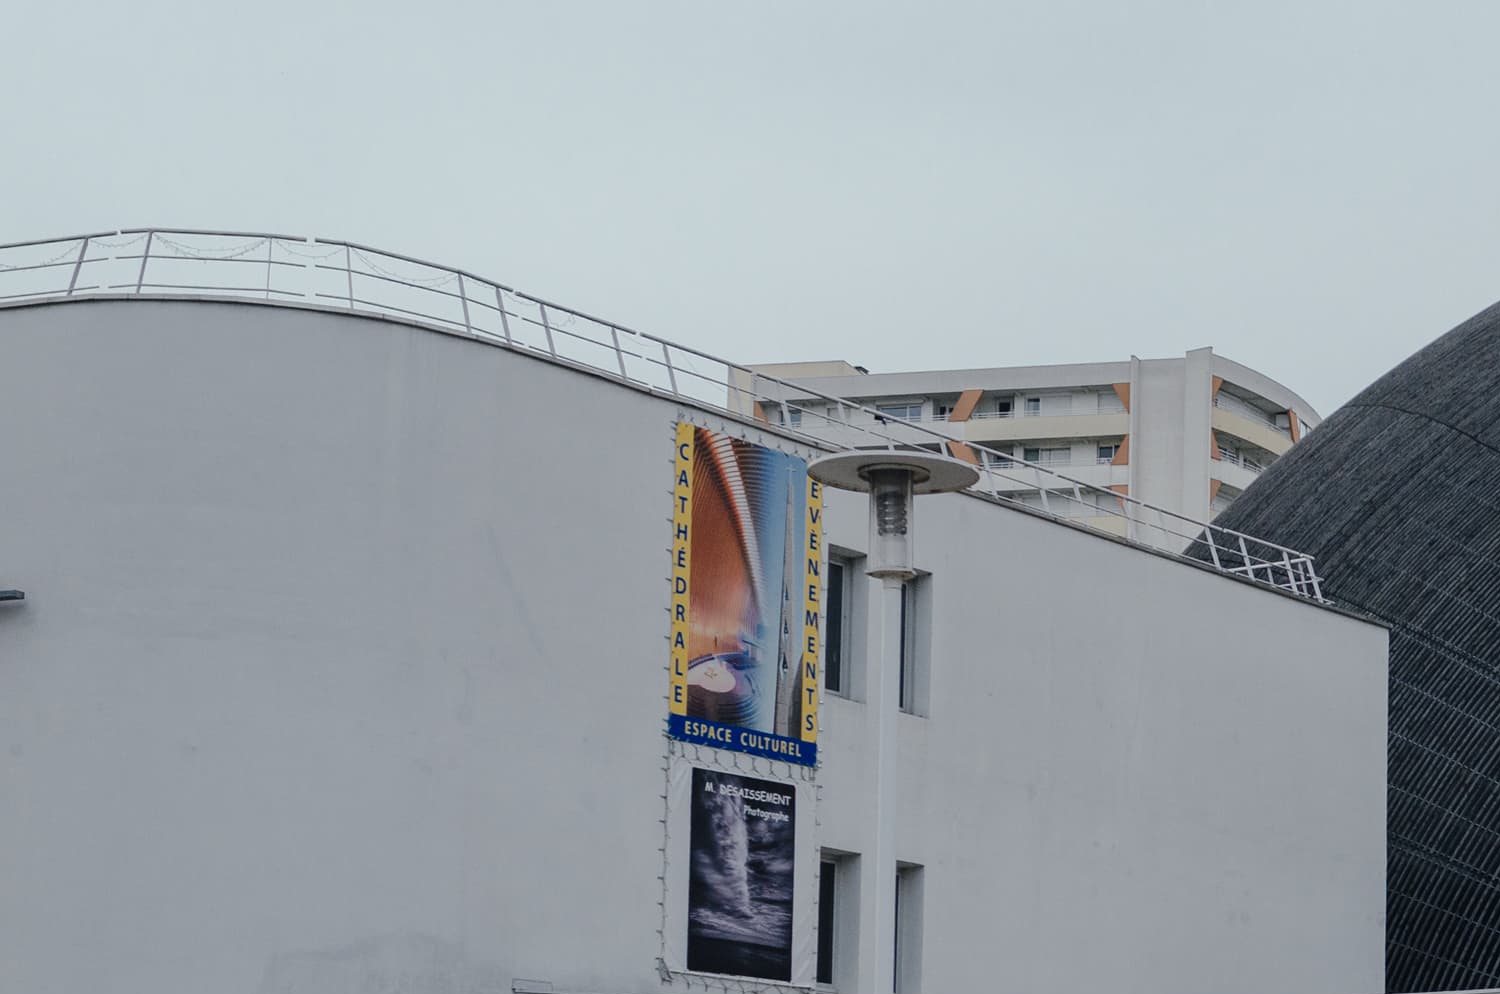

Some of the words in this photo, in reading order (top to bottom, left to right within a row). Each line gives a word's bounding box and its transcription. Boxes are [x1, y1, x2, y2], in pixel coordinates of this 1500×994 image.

[673, 442, 690, 704] CATHÉDRALE
[684, 720, 732, 744] ESPACE
[740, 732, 802, 757] CULTUREL
[704, 781, 717, 794] M.
[743, 804, 789, 823] Photographe
